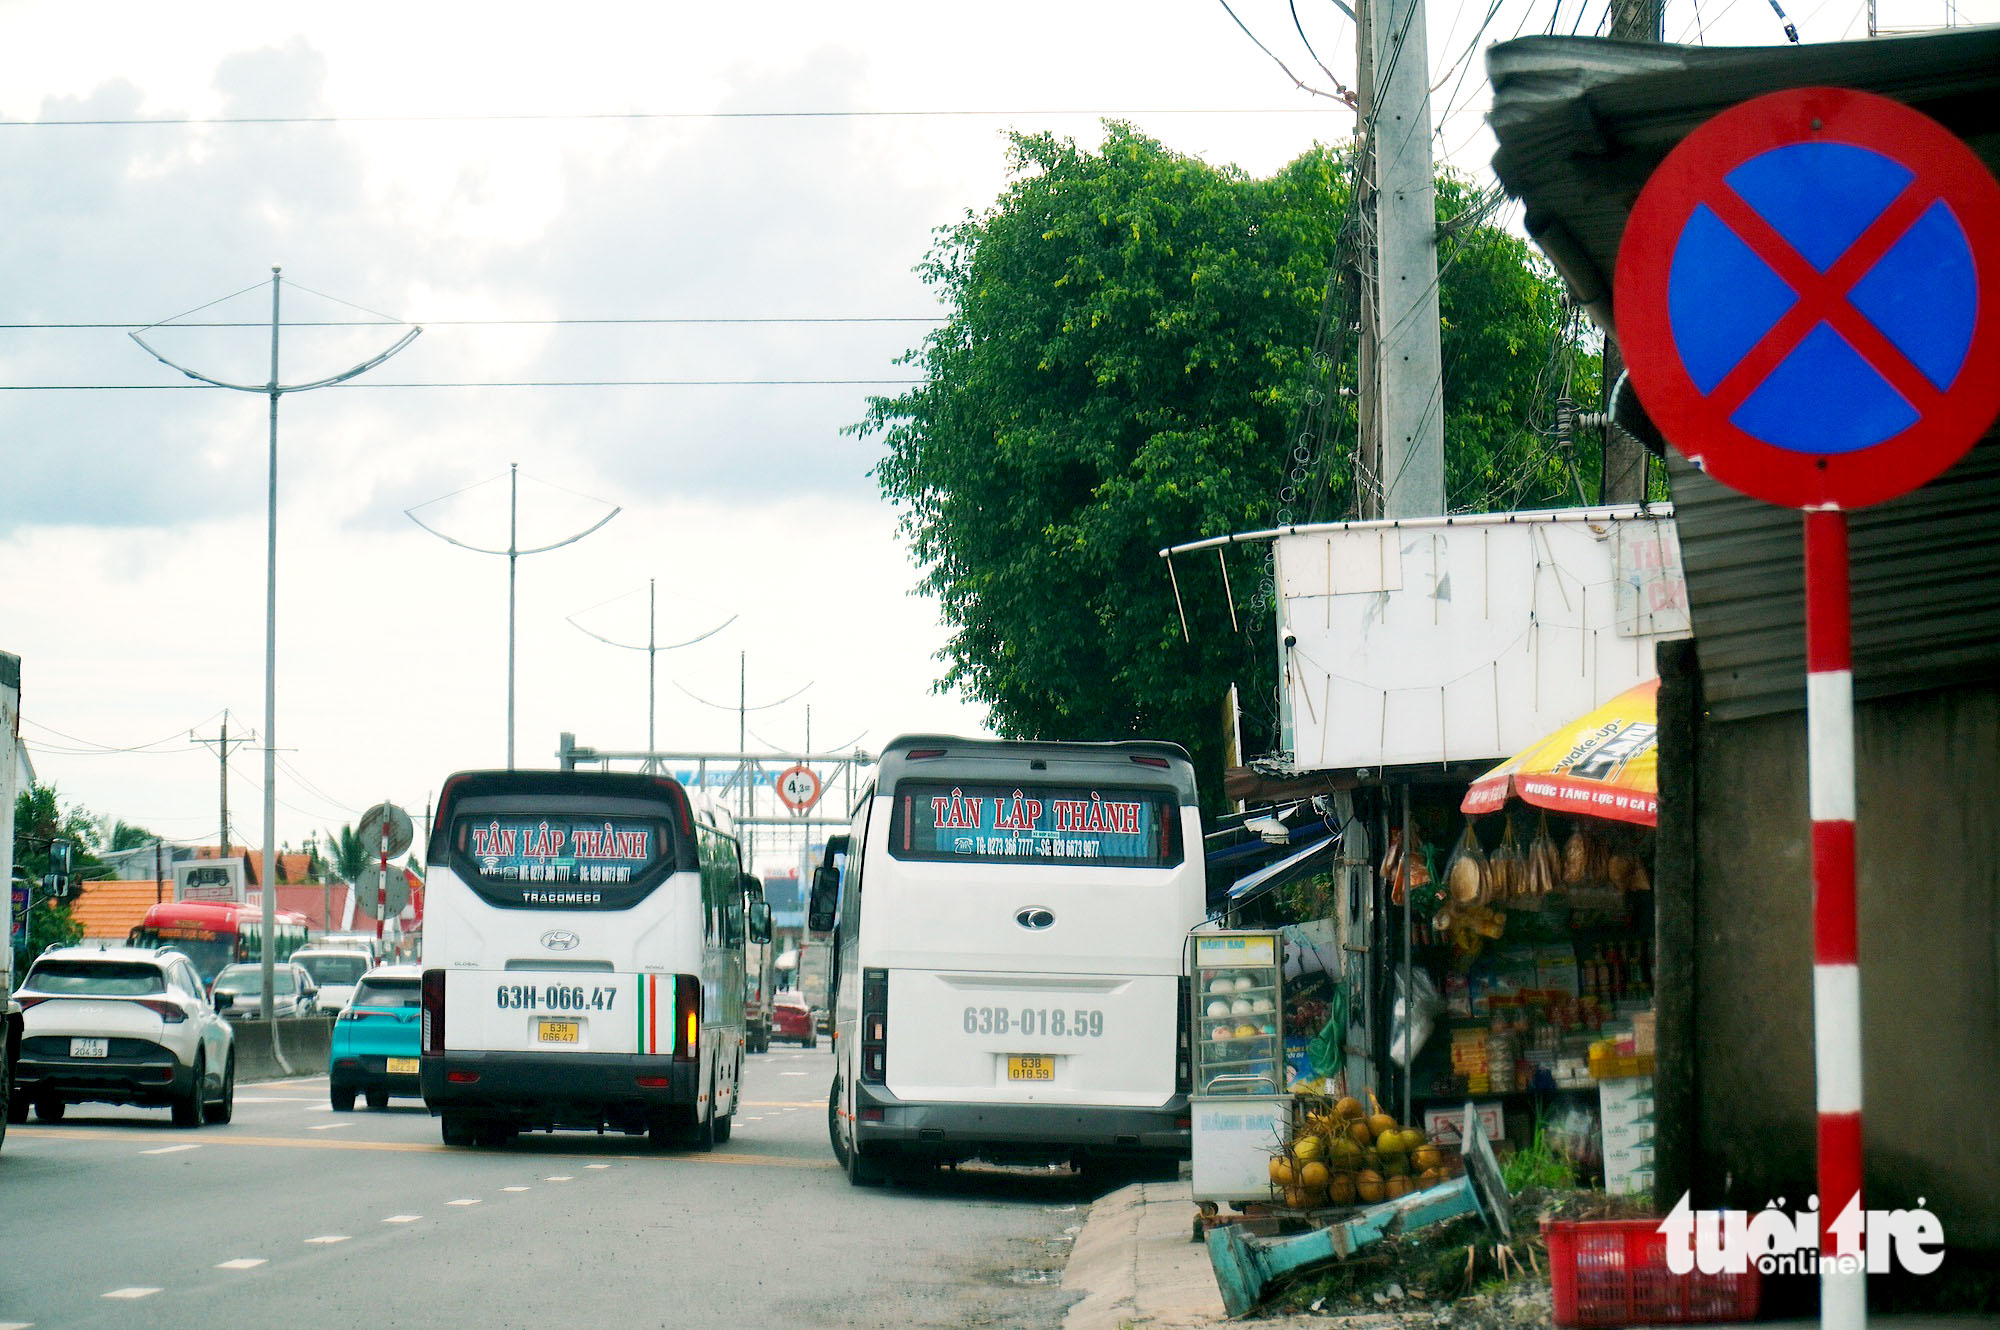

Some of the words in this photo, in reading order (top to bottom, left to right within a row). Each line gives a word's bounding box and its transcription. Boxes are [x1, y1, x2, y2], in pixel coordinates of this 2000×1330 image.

[930, 786, 983, 829] TÂN
[993, 788, 1043, 839] LẬP
[1052, 790, 1141, 834] THÀNH
[472, 820, 517, 857] TÂN
[522, 820, 565, 865] LẬP
[571, 822, 648, 860] THÀNH
[987, 837, 1003, 855] 0273
[1004, 837, 1017, 856] 366
[1017, 838, 1034, 856] 7777
[1052, 838, 1065, 857] 028
[1066, 839, 1082, 857] 6673
[1083, 840, 1100, 858] 9977
[522, 892, 601, 904] TRACOMECO
[497, 985, 617, 1011] 63H-066.47
[550, 1024, 568, 1033] 63H
[963, 1007, 1104, 1038] 63B-018.59
[542, 1033, 574, 1042] 066.47
[1021, 1058, 1041, 1068] 63B
[1012, 1068, 1049, 1079] 018.59
